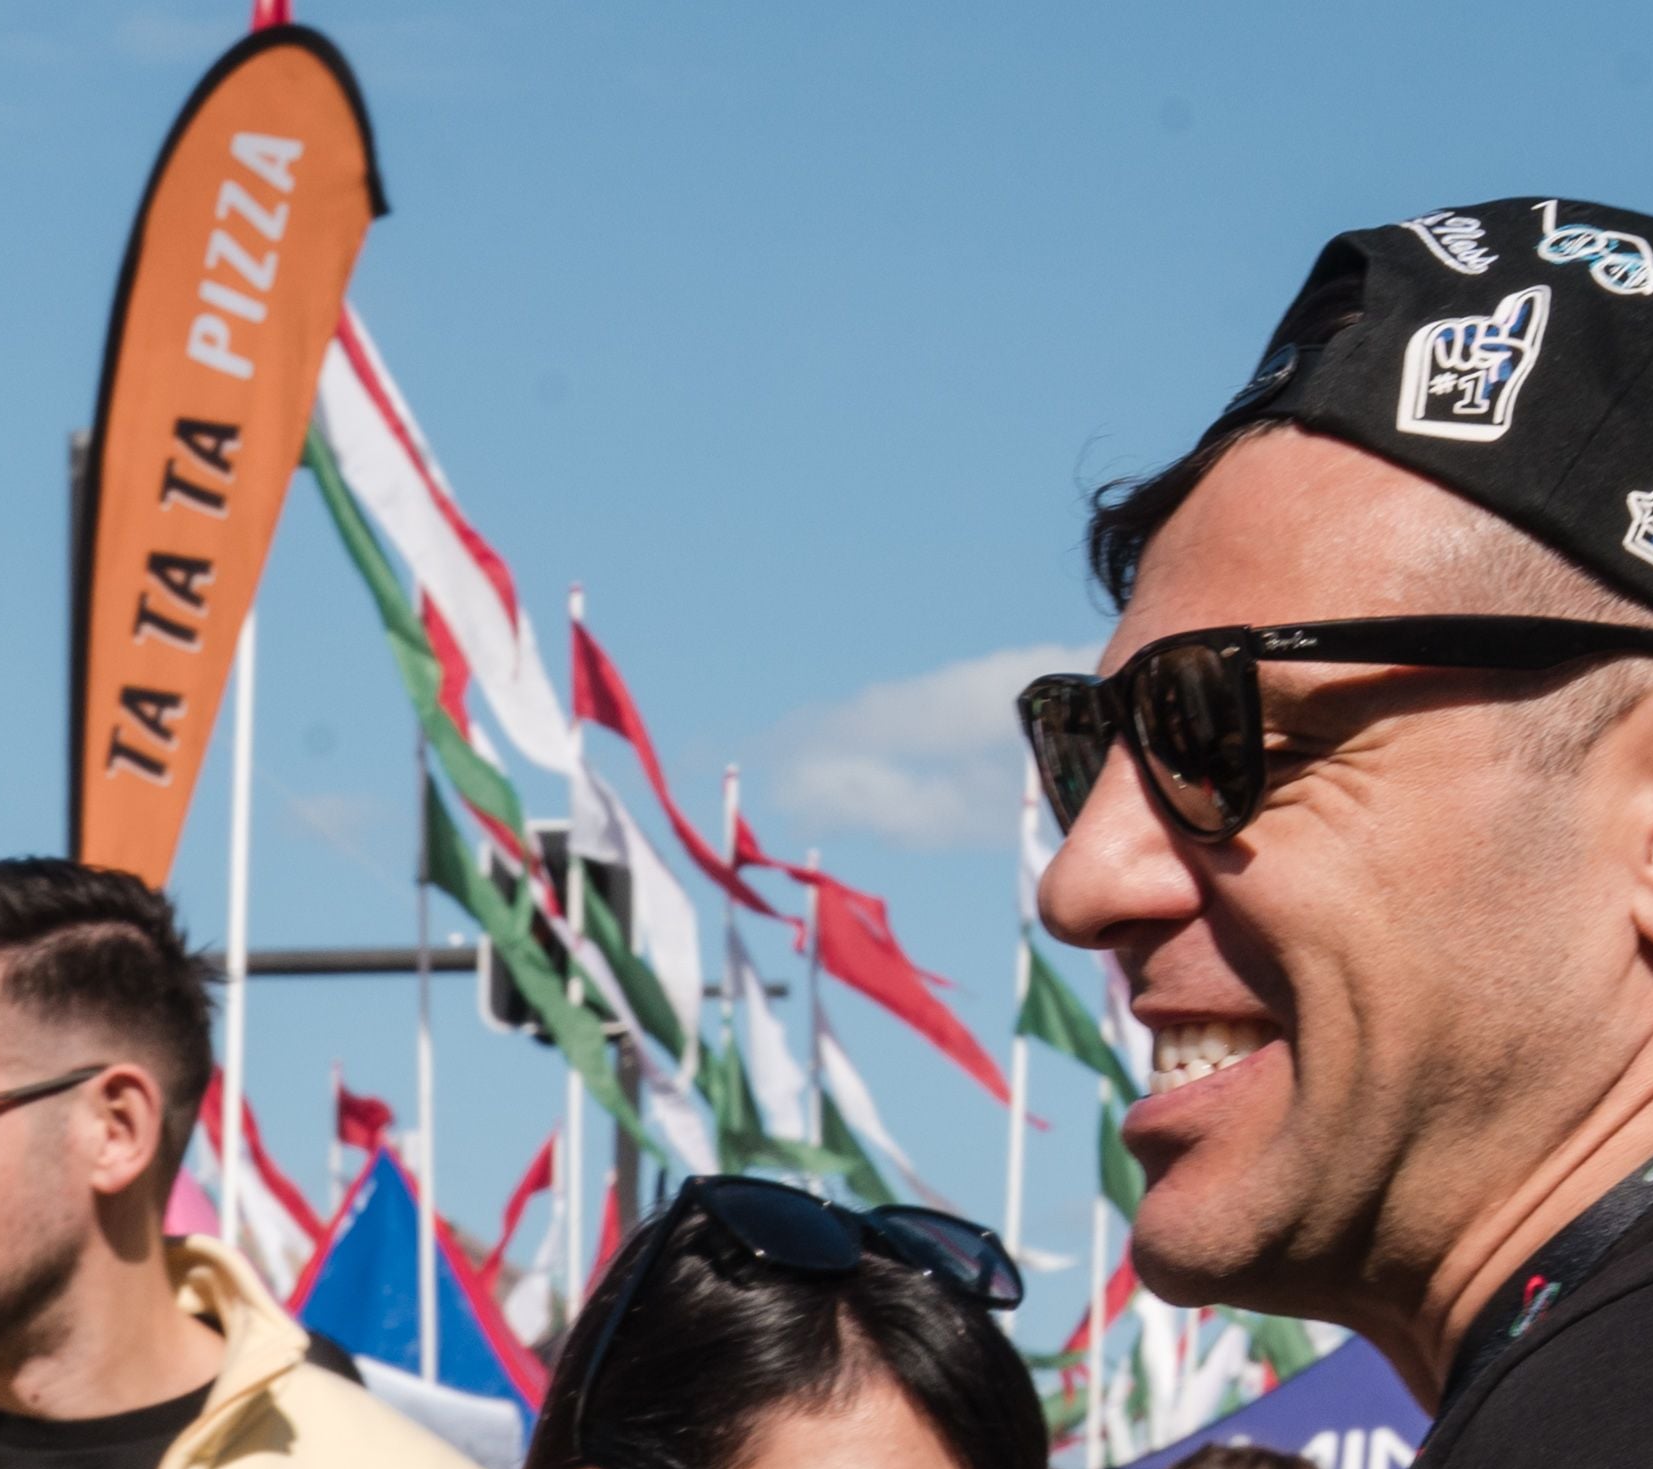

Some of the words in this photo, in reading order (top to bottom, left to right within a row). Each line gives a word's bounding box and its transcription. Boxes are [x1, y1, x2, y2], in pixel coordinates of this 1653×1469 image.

[187, 133, 303, 379] PIZZA
[1428, 369, 1490, 414] #1
[159, 417, 243, 520] TA
[132, 551, 217, 653] TA
[105, 686, 185, 787] TA
